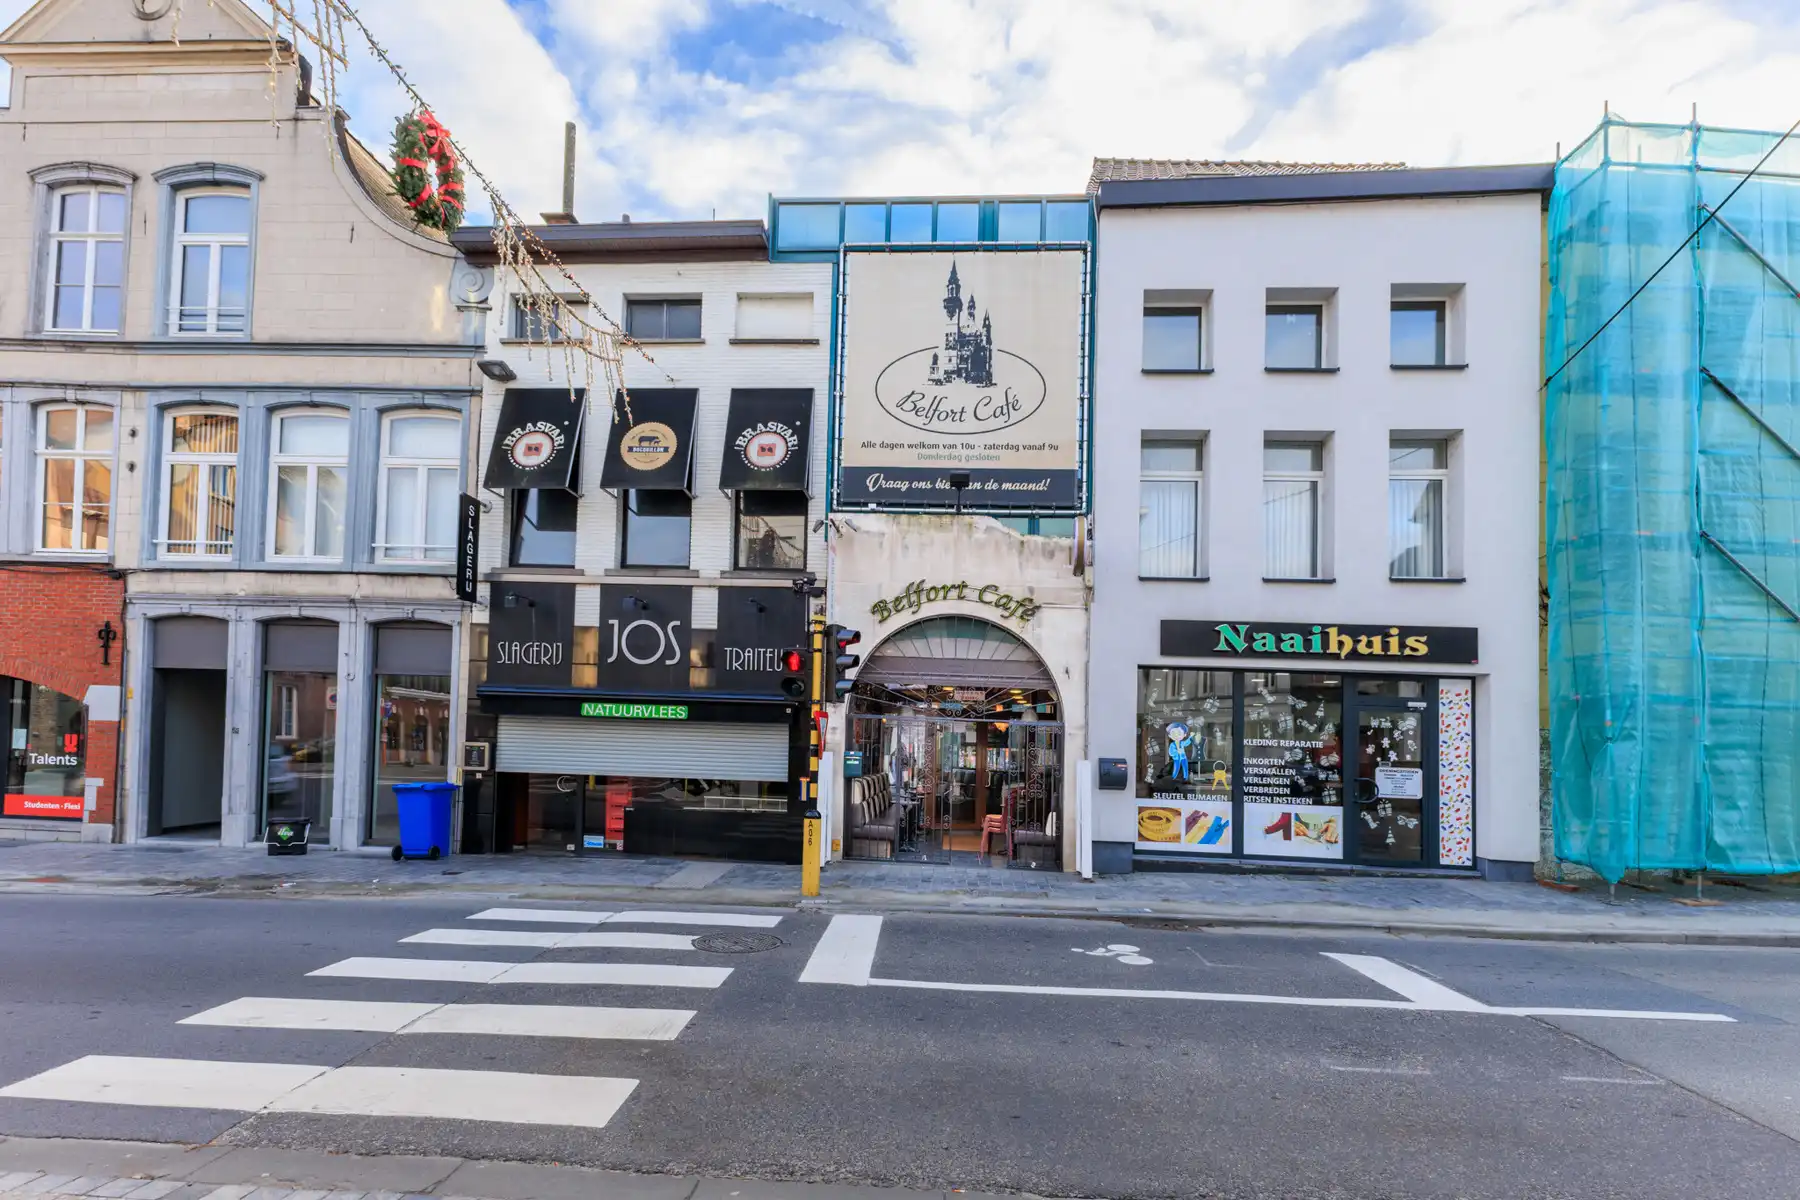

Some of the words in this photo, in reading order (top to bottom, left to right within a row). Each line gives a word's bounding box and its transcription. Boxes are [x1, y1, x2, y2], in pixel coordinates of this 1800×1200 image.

[896, 390, 967, 426] Belfort
[973, 387, 1022, 424] Café
[503, 421, 565, 449] BRASVAR
[735, 421, 799, 447] BRASVAR
[861, 441, 877, 449] Alle
[879, 441, 905, 452] dagen
[907, 442, 940, 450] welkom
[960, 442, 976, 450] 10u
[983, 443, 1020, 453] zaterdag
[1022, 443, 1046, 451] vanaf
[1048, 443, 1059, 451] 9u
[917, 453, 962, 462] Donderdag
[964, 453, 1000, 463] gesloten
[866, 472, 911, 492] Vraag
[911, 479, 932, 489] ons
[935, 477, 954, 489] bie
[984, 478, 999, 490] de
[1001, 478, 1051, 491] maand!
[870, 578, 969, 624] Belfort
[607, 619, 681, 665] JOS
[1213, 623, 1429, 659] Naaihuis
[496, 641, 564, 666] SLAGERIJ
[724, 647, 784, 672] TRAITEU
[583, 703, 687, 719] NATUURVLEES
[1243, 738, 1278, 748] KLEDING
[1280, 739, 1324, 749] REPARATIE
[29, 753, 77, 765] Talents
[1243, 757, 1285, 766] INKORTEN
[1243, 767, 1296, 776] VERSMALLEN
[1243, 776, 1290, 785] VERLENGEN
[1153, 792, 1185, 800] SLEUTEL
[1243, 786, 1290, 795] VERBREDEN
[24, 801, 60, 809] Studenten
[1243, 795, 1271, 804] RITSEN
[1273, 796, 1313, 805] INSTEKEN
